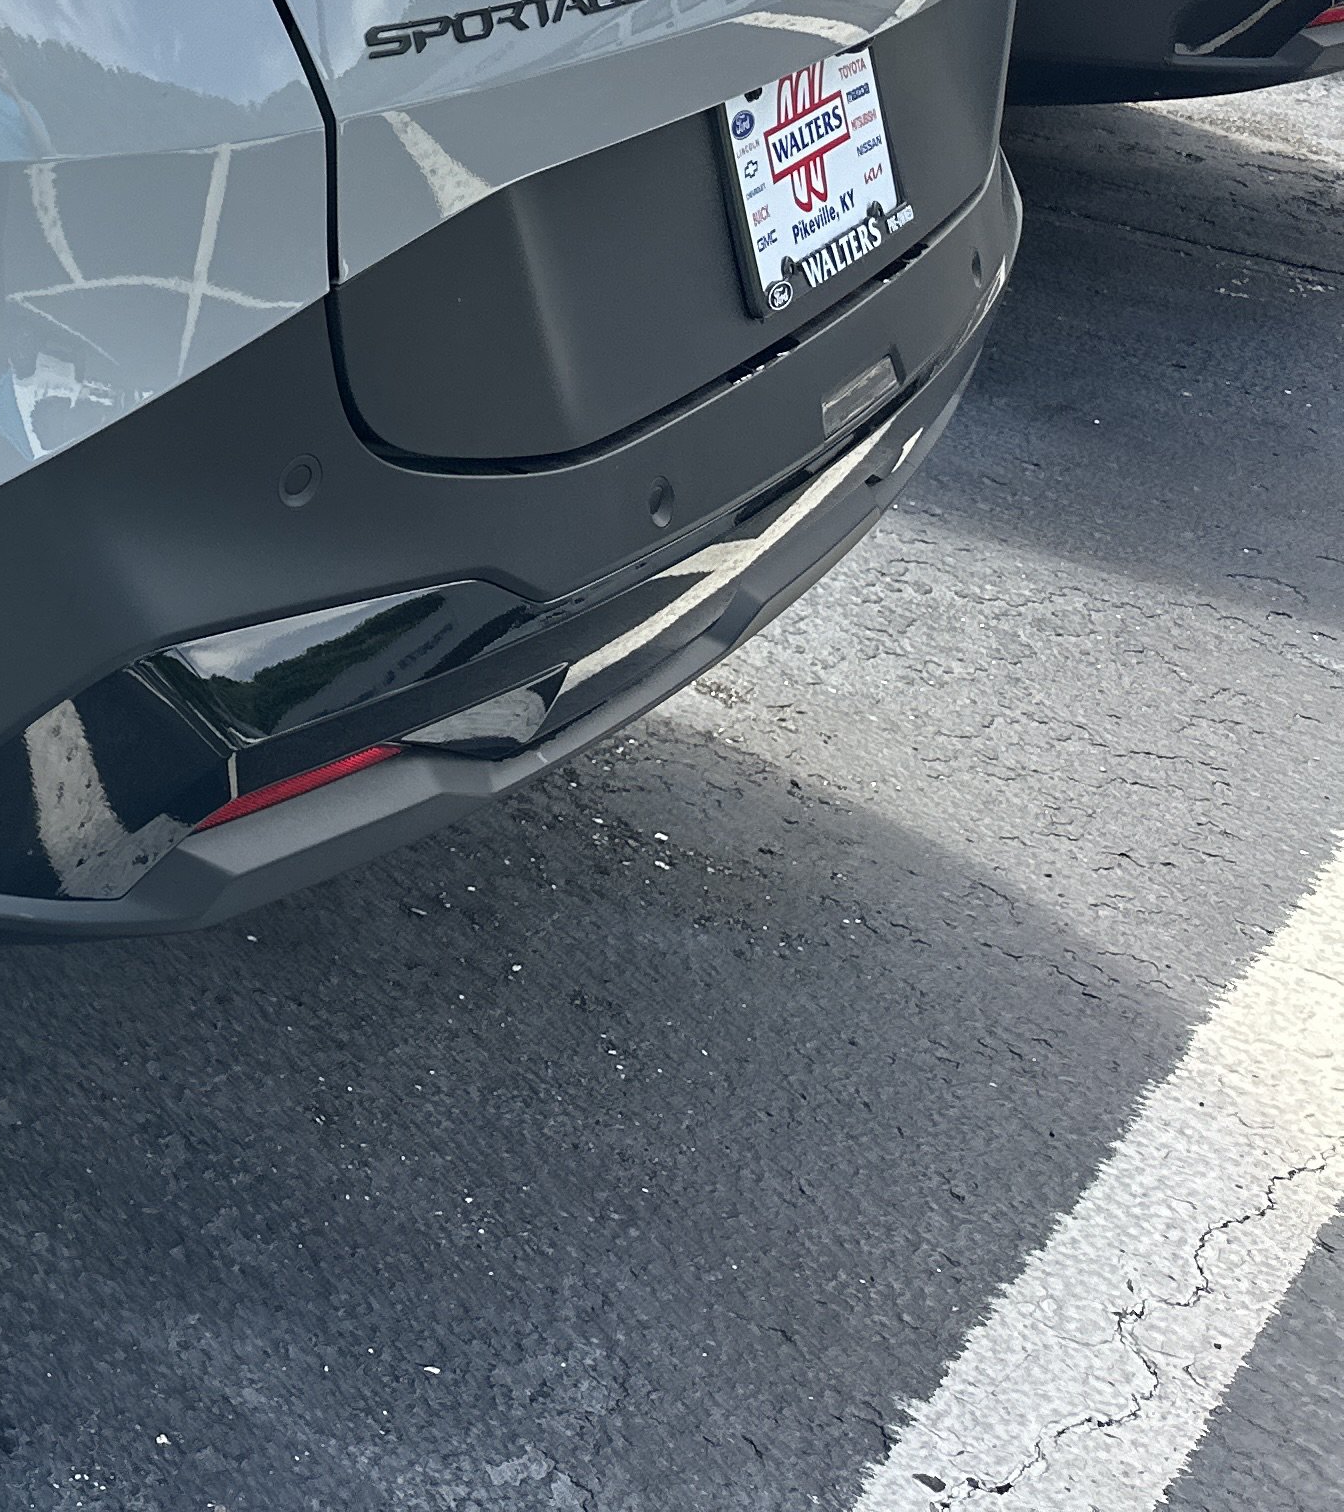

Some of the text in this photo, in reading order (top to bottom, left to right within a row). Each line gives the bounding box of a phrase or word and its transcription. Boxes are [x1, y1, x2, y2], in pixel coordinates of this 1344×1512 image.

[838, 57, 867, 81] TOYOTA
[771, 104, 844, 164] WALTERS
[856, 134, 883, 157] NISSAN
[735, 139, 760, 159] LINCOLN
[791, 187, 856, 245] Pikeville, KY
[756, 228, 778, 253] GMC
[801, 216, 882, 288] WALTERS
